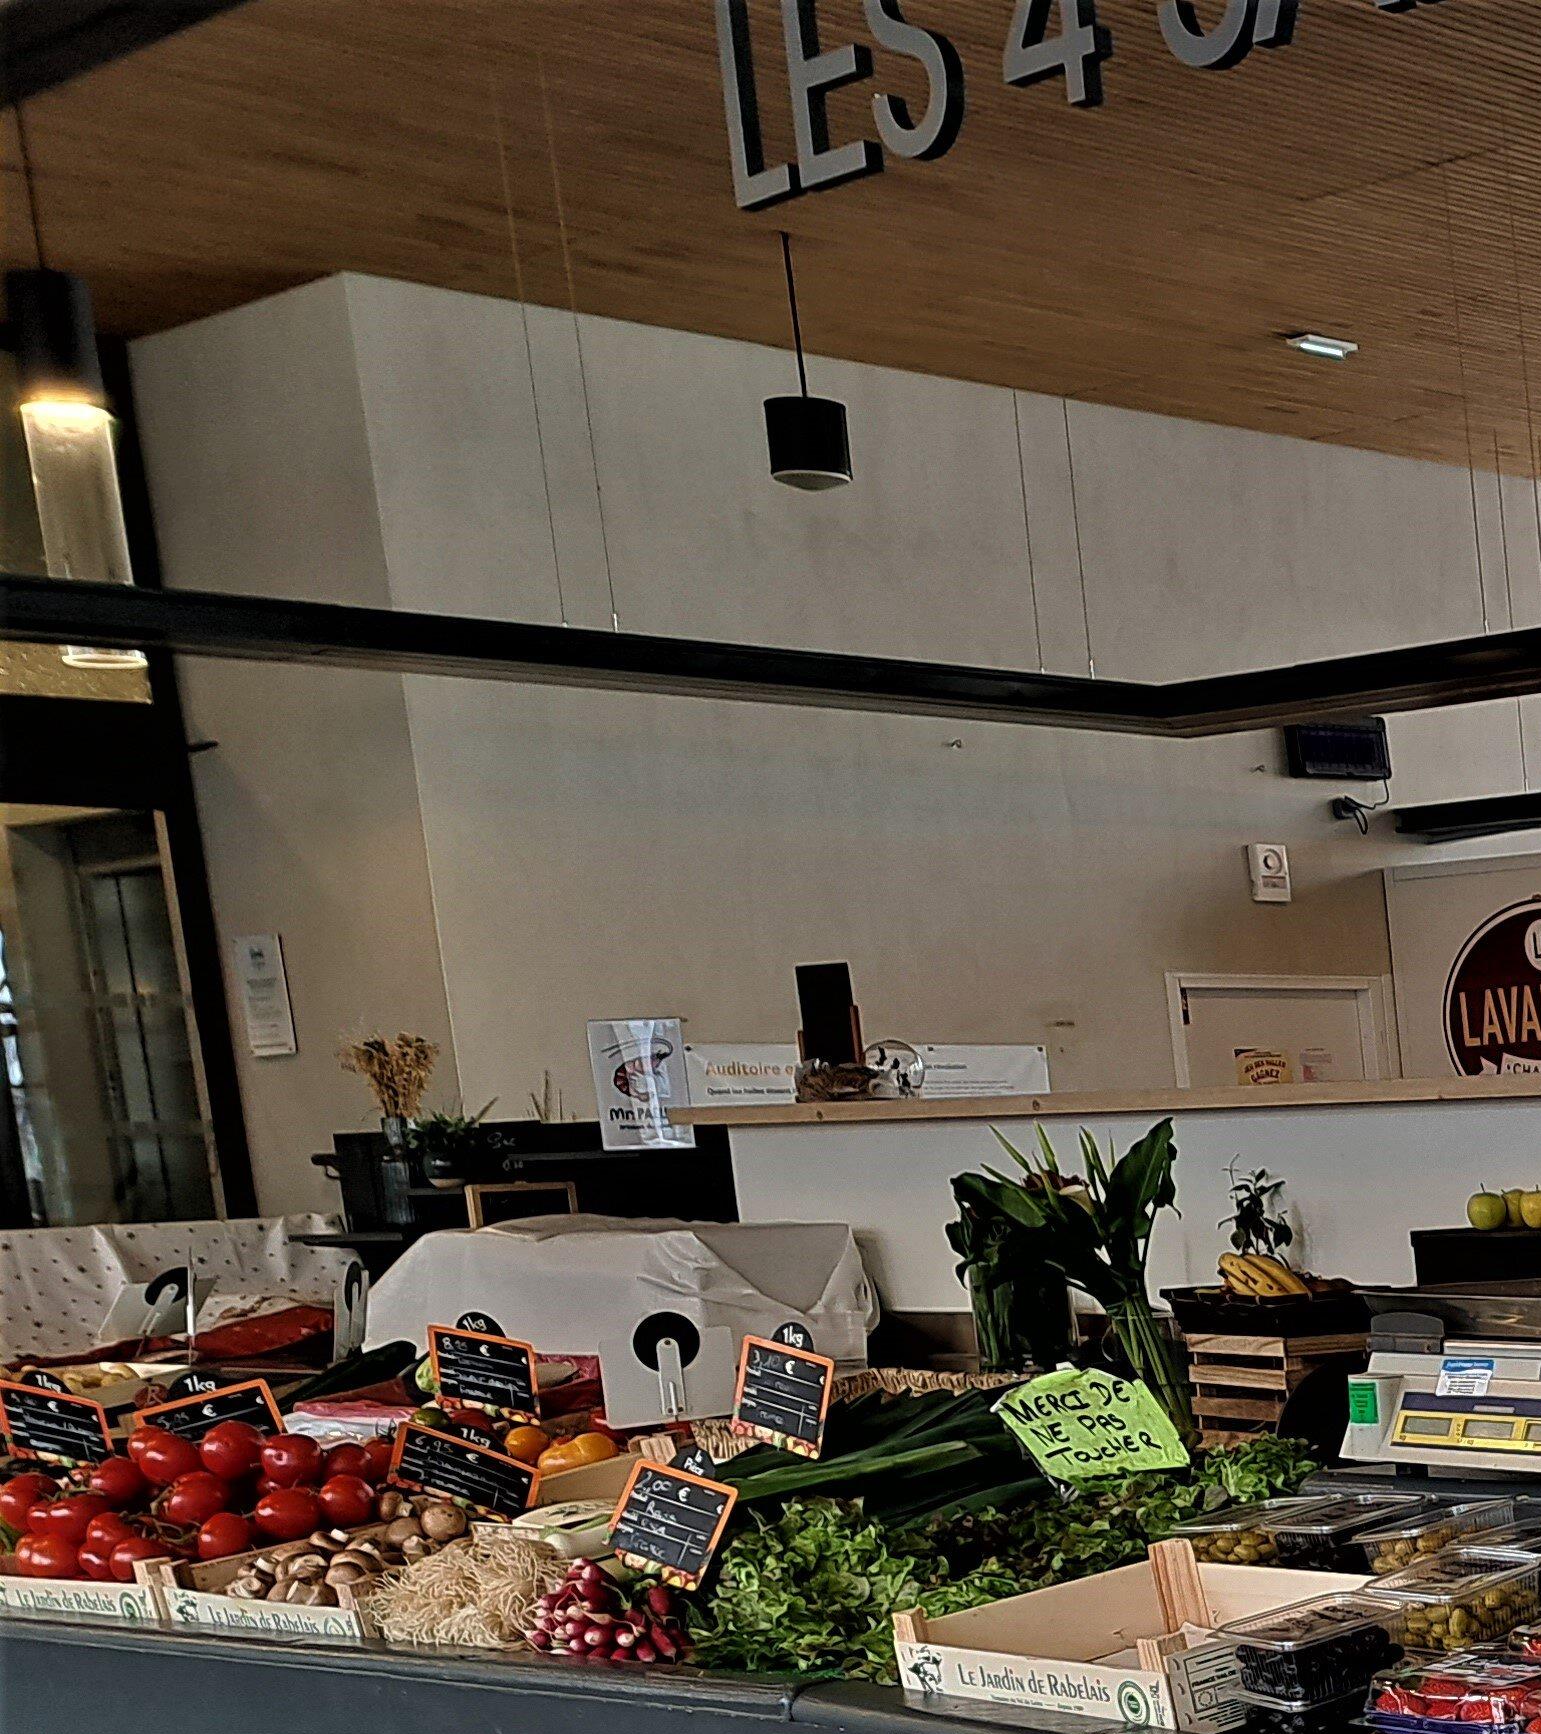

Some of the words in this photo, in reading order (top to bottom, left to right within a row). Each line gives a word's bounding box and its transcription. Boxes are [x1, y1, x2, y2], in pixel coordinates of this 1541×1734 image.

[716, 0, 960, 209] LES
[782, 1327, 804, 1347] 1kg
[1002, 1389, 1091, 1426] MERCI
[1089, 1380, 1131, 1407] DE
[460, 1427, 491, 1449] 1kg
[1029, 1421, 1071, 1448] NE
[1077, 1412, 1127, 1437] PAS
